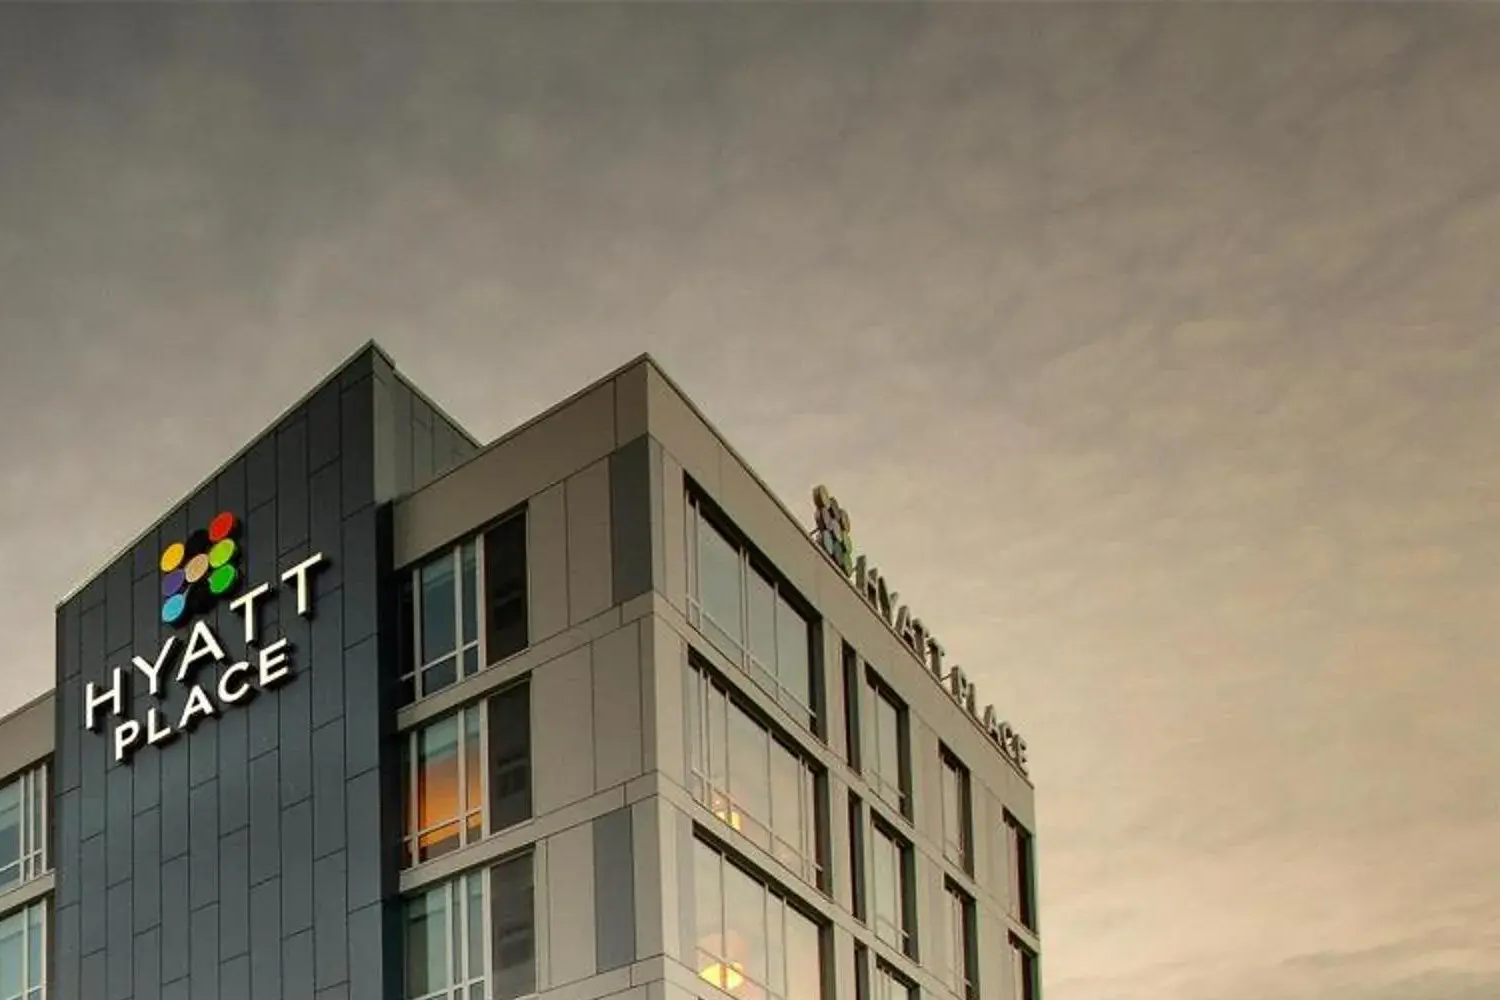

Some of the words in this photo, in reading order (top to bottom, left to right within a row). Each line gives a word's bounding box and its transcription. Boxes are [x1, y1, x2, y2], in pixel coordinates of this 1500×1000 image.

[85, 551, 323, 730] HYATT
[114, 637, 289, 761] PLACE
[950, 665, 1029, 777] PLACE
